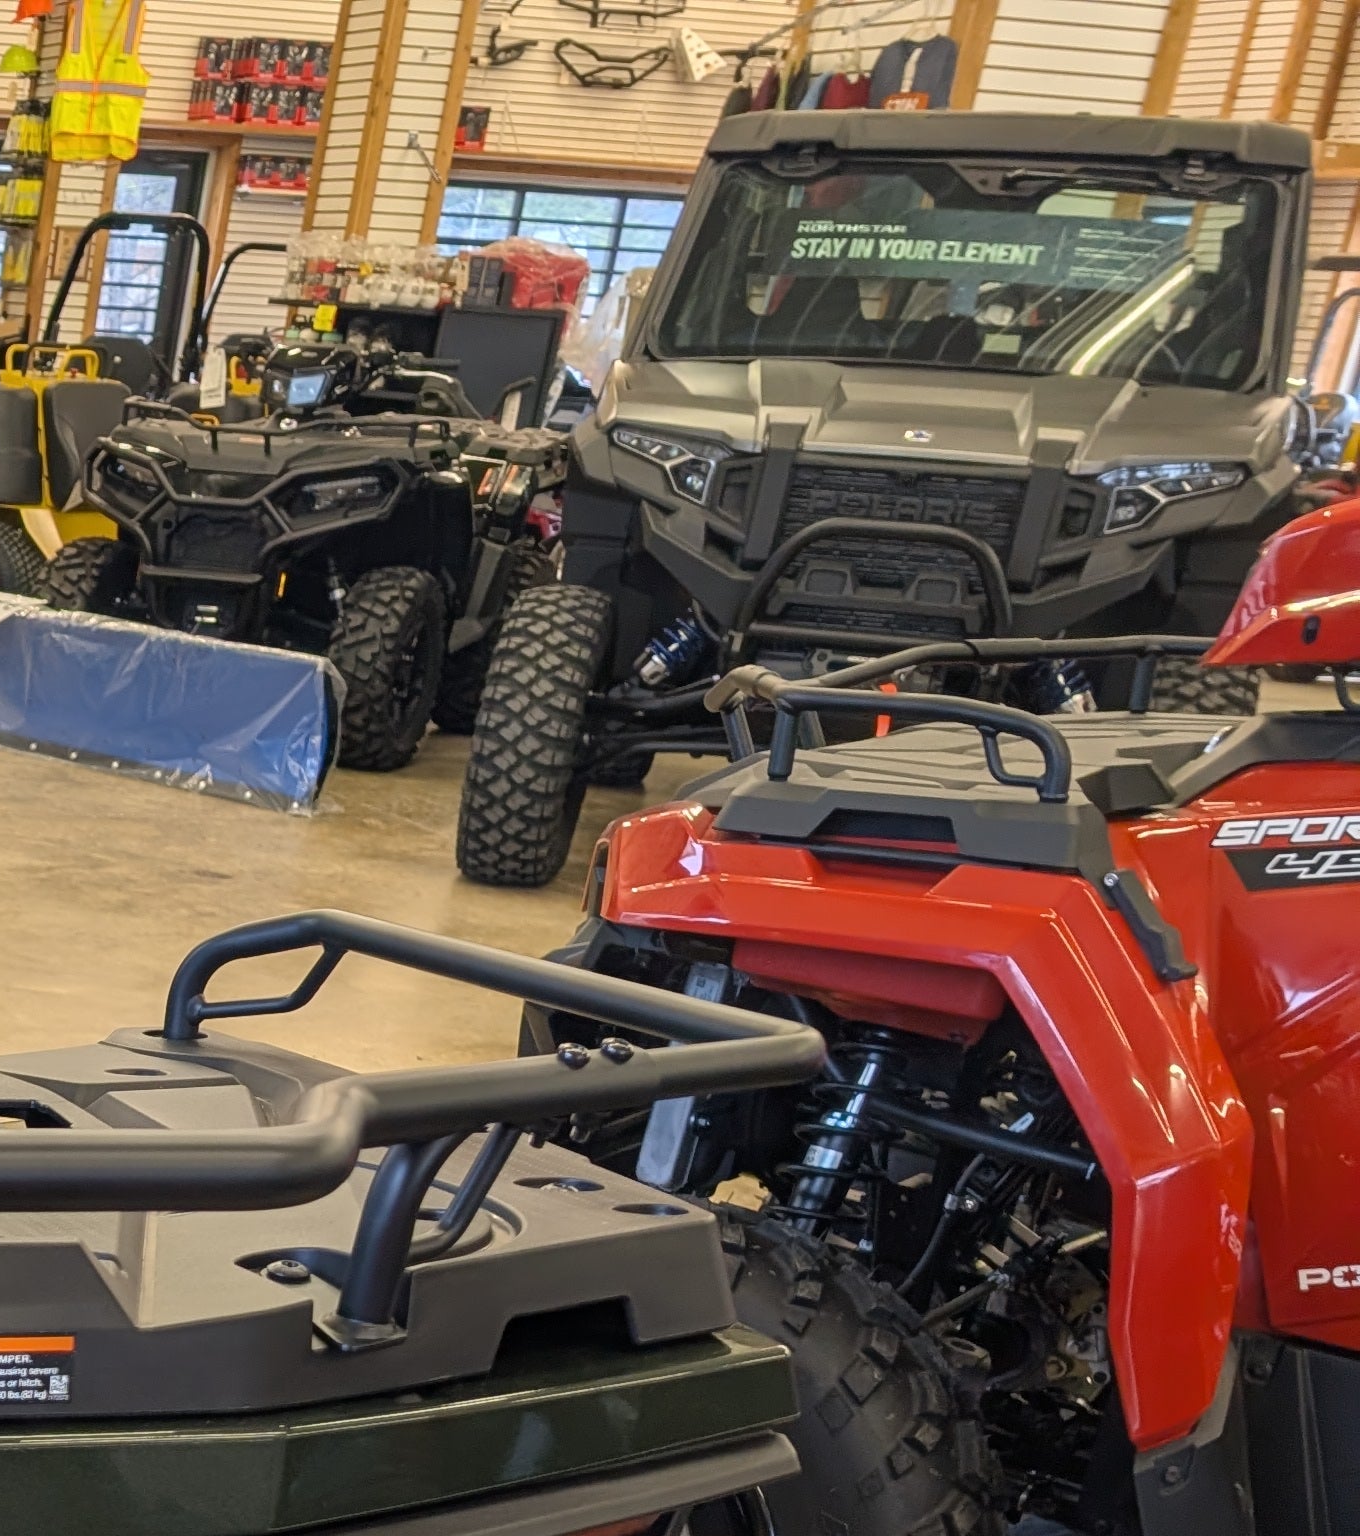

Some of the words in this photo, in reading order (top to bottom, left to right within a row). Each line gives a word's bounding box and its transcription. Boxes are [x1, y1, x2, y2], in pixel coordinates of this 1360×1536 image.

[791, 238, 848, 259] STAY
[848, 238, 875, 259] IN
[879, 239, 937, 260] YOUR
[938, 241, 1045, 266] ELEMENT
